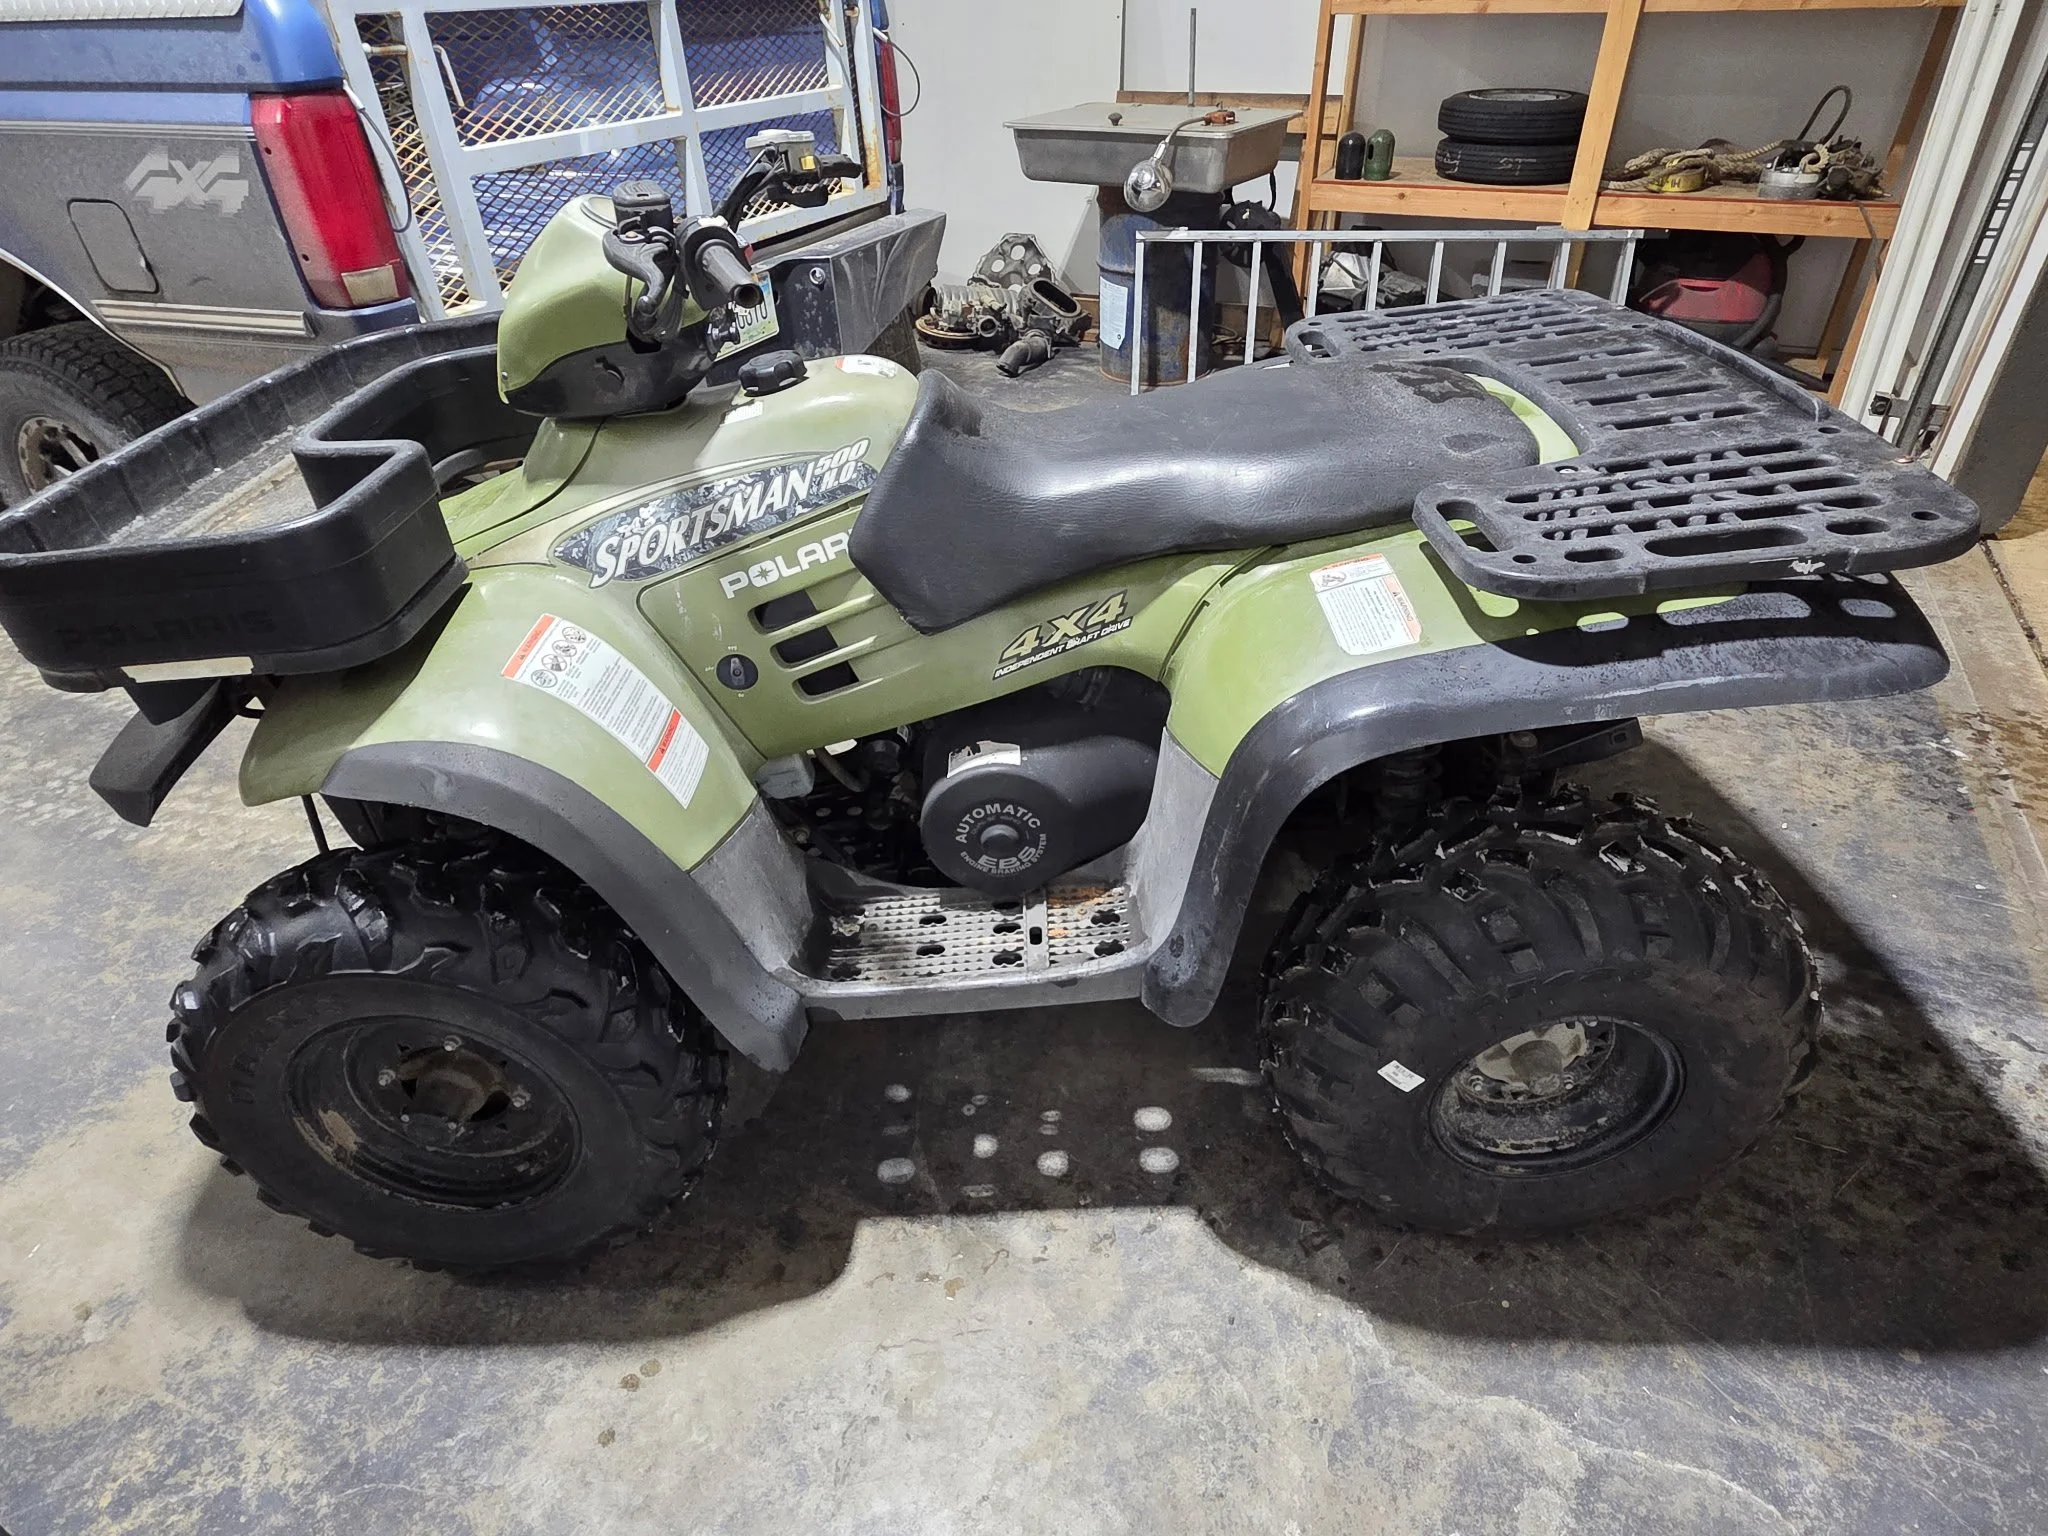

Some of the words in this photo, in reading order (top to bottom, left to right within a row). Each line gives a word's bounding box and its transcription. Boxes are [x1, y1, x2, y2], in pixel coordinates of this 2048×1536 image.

[590, 461, 815, 588] SPORTSMAN
[814, 438, 870, 477] 500
[719, 529, 852, 600] POLAR
[994, 645, 1065, 679] INDEPENDENT
[955, 802, 1041, 844] AUTOMATIC
[960, 851, 990, 873] ENGINE
[991, 861, 1032, 875] BRAKING
[1030, 833, 1047, 863] SYSTEM
[978, 846, 1037, 870] EBS
